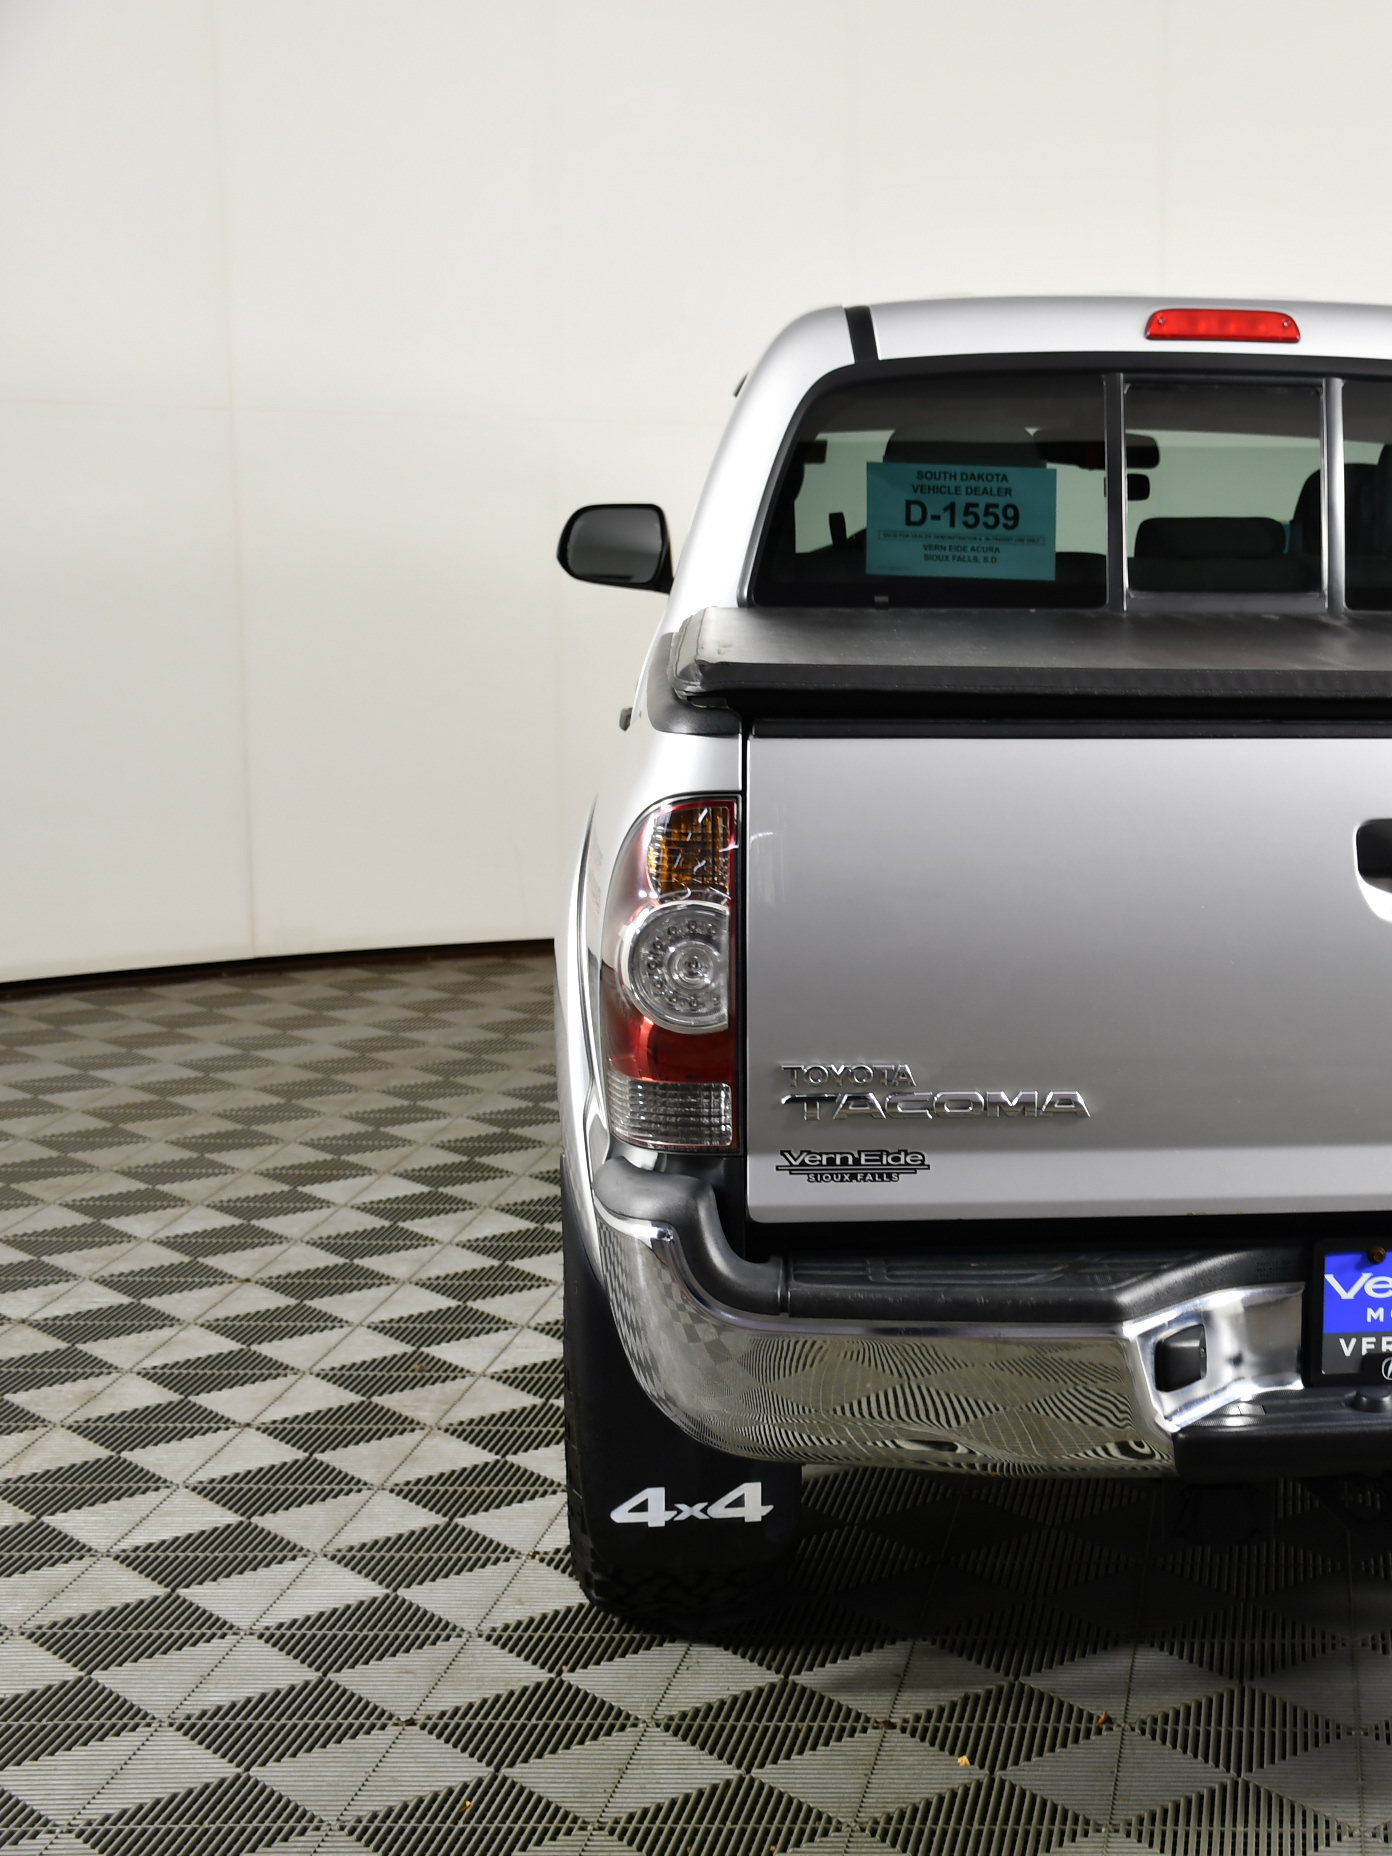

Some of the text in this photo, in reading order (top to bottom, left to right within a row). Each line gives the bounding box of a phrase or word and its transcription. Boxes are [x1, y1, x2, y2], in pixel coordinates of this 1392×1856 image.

[916, 470, 1009, 483] SOUTH DAKOTA
[911, 484, 1013, 497] VEHICLE DEALER
[904, 499, 1020, 531] D-1559
[922, 543, 1001, 554] VERN EIDE ACURA
[923, 553, 950, 562] SIOUX
[780, 1063, 917, 1087] TOYOTA
[780, 1090, 1091, 1120] TACOMA
[783, 1150, 925, 1166] Vern Eide
[807, 1173, 899, 1182] SIOUX FALLS
[610, 1481, 774, 1527] 4x4
